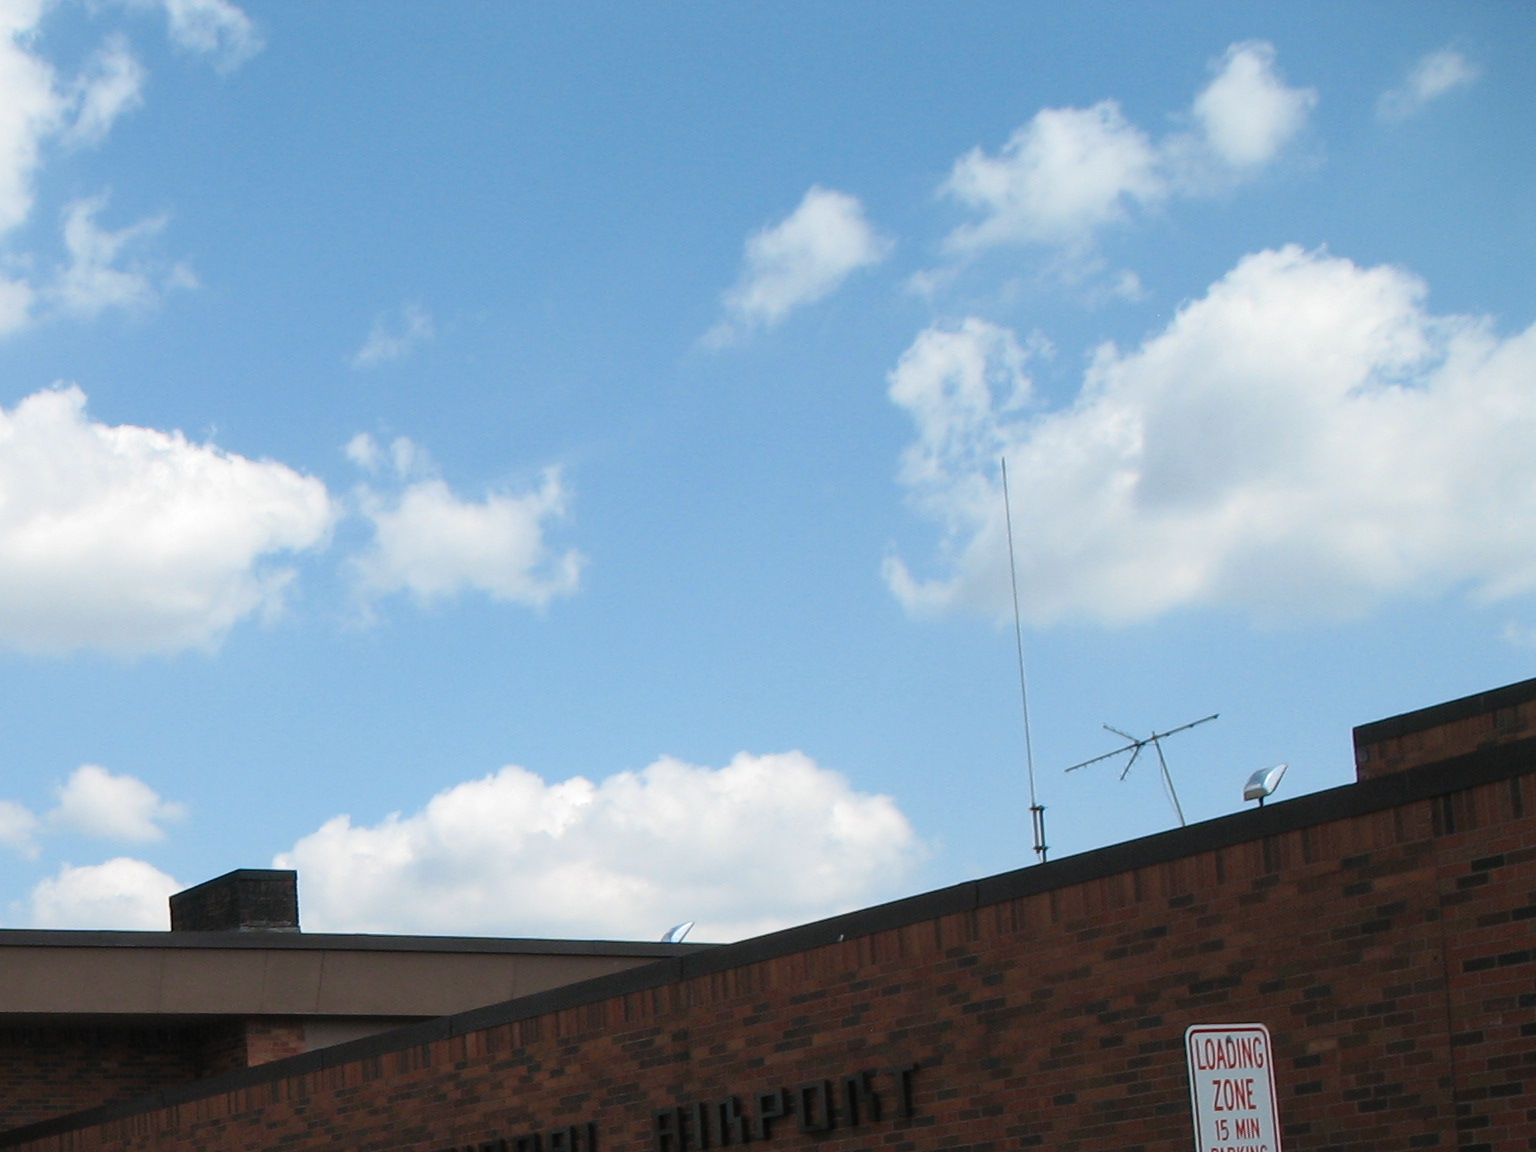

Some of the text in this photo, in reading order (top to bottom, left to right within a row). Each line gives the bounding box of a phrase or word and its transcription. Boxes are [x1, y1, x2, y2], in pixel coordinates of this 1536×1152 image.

[1195, 1037, 1264, 1070] LOADING
[1212, 1079, 1257, 1111] ZONE
[1215, 1118, 1261, 1141] 15 MIN
